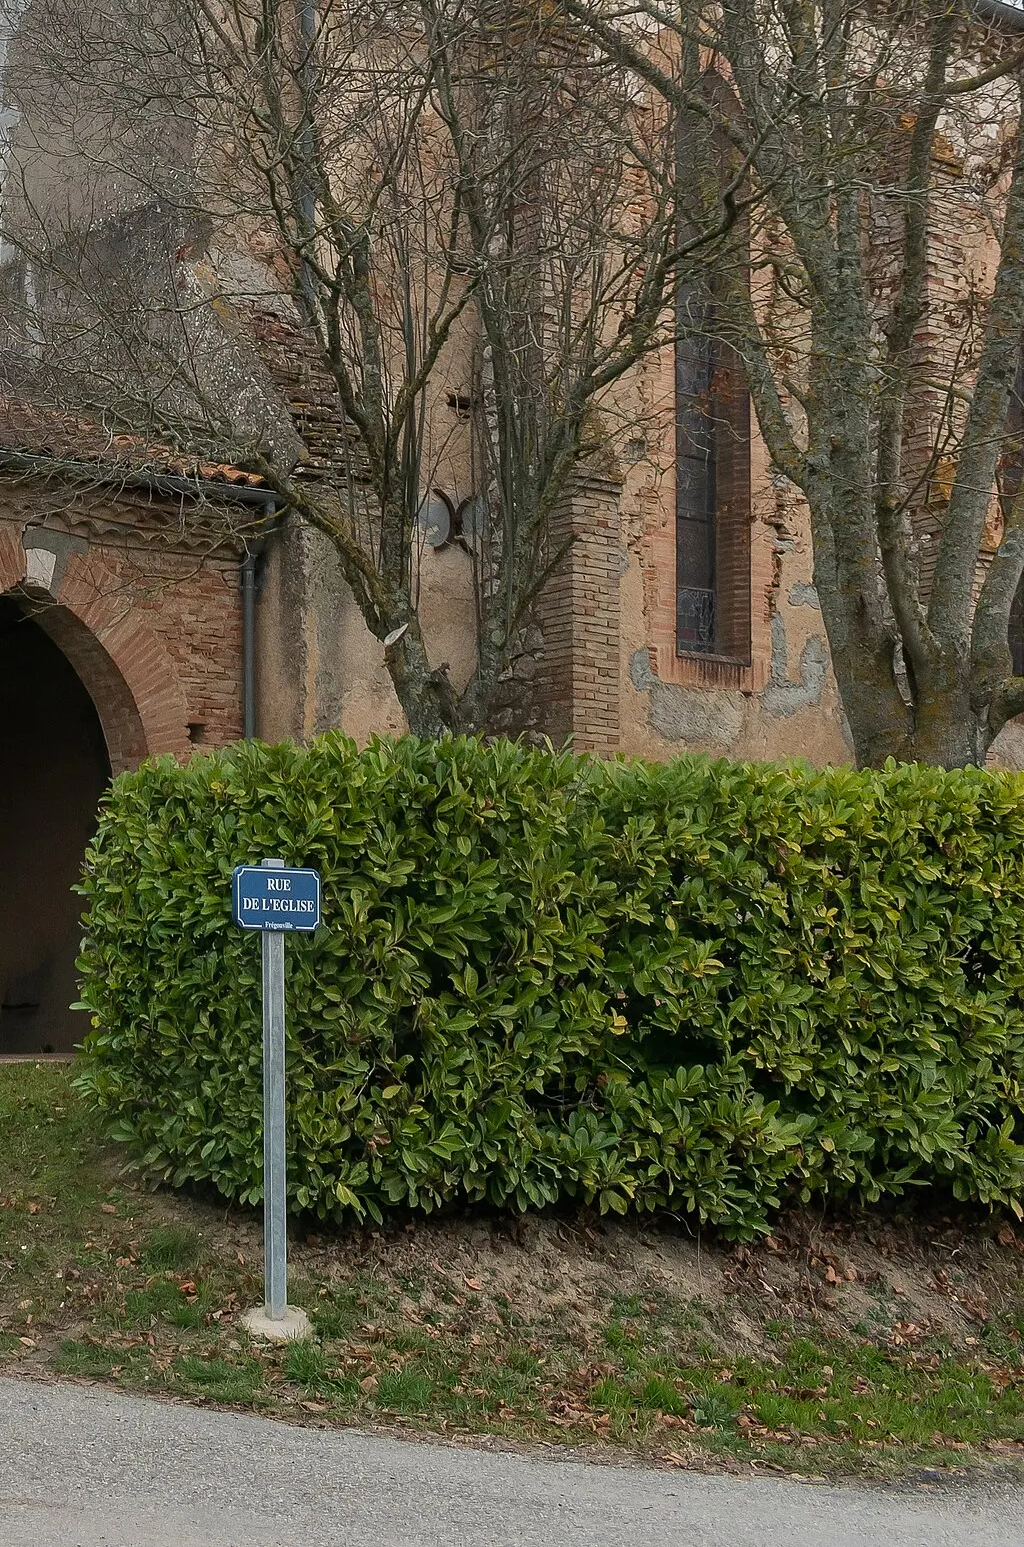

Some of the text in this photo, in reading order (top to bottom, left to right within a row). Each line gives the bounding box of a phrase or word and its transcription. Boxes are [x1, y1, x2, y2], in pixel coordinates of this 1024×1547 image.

[267, 878, 291, 891] RUE
[243, 897, 315, 912] DE L'EGLISE
